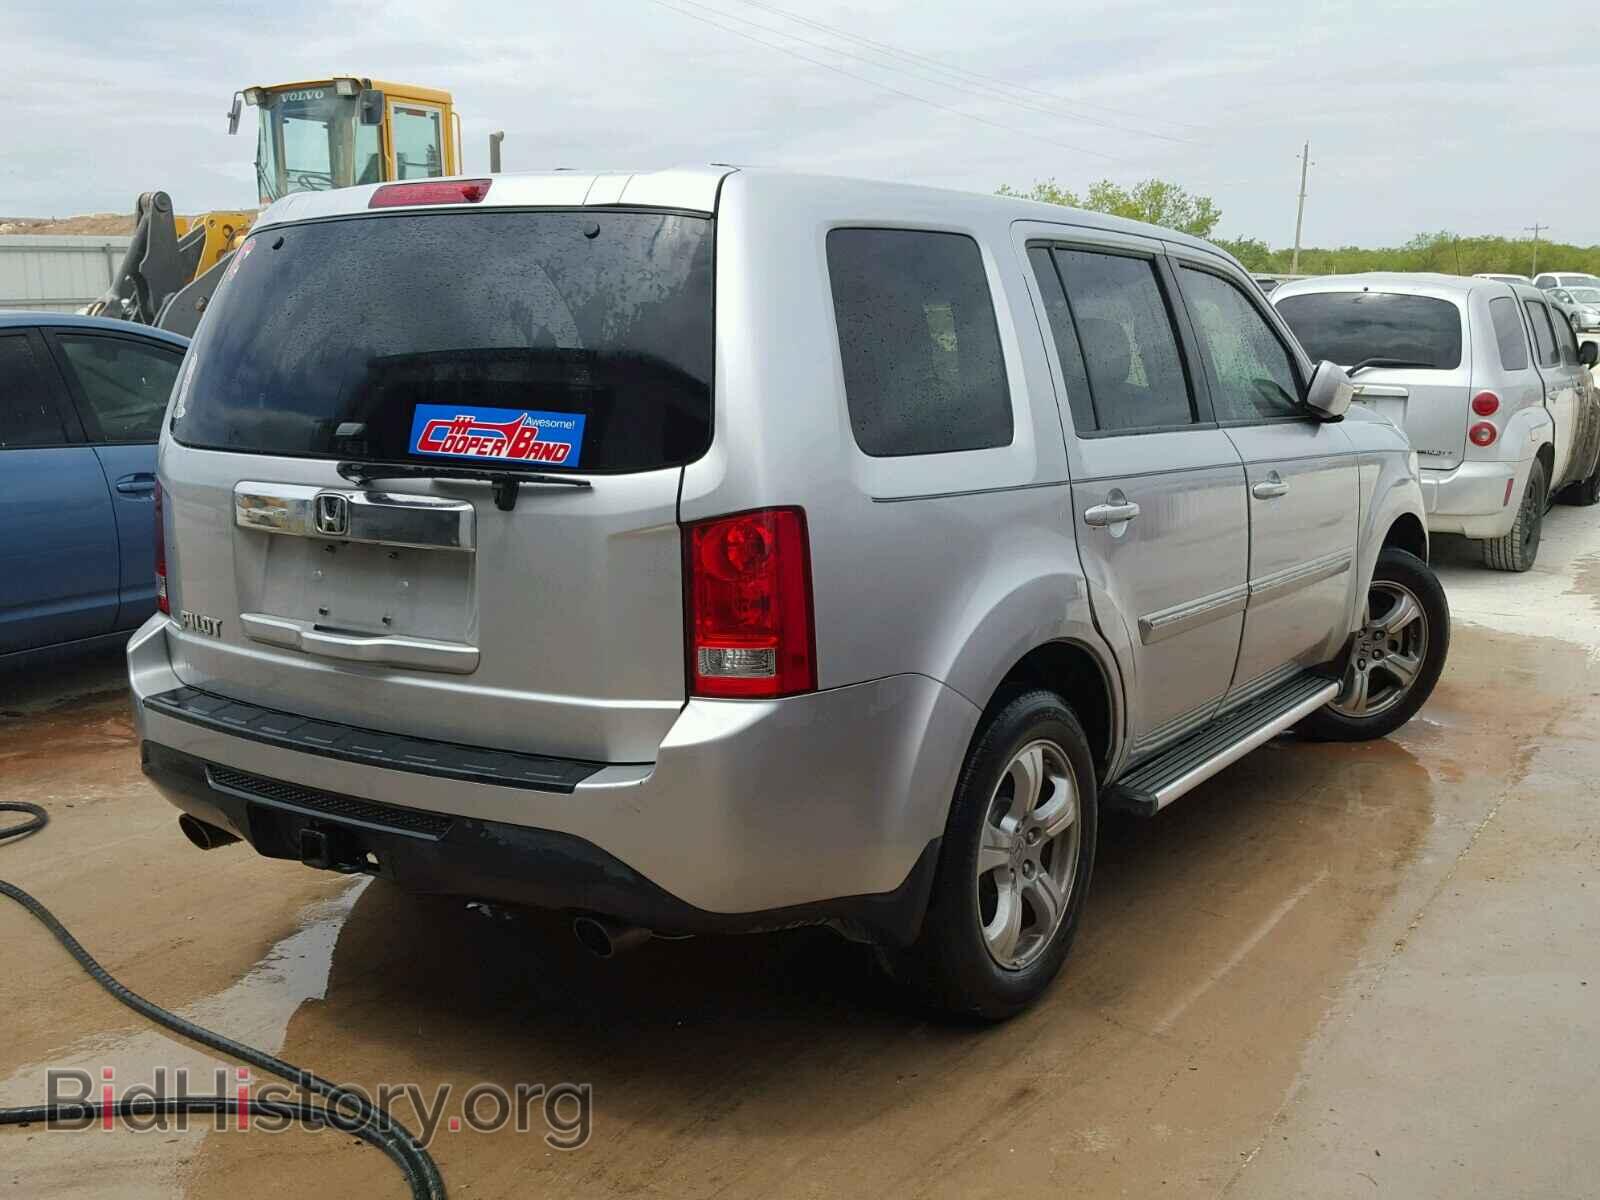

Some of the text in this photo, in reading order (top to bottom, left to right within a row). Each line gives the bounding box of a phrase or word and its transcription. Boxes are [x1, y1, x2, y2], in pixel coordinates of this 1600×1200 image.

[281, 90, 324, 102] VOLVO
[525, 416, 575, 430] Awesome!
[181, 609, 223, 638] PILOT
